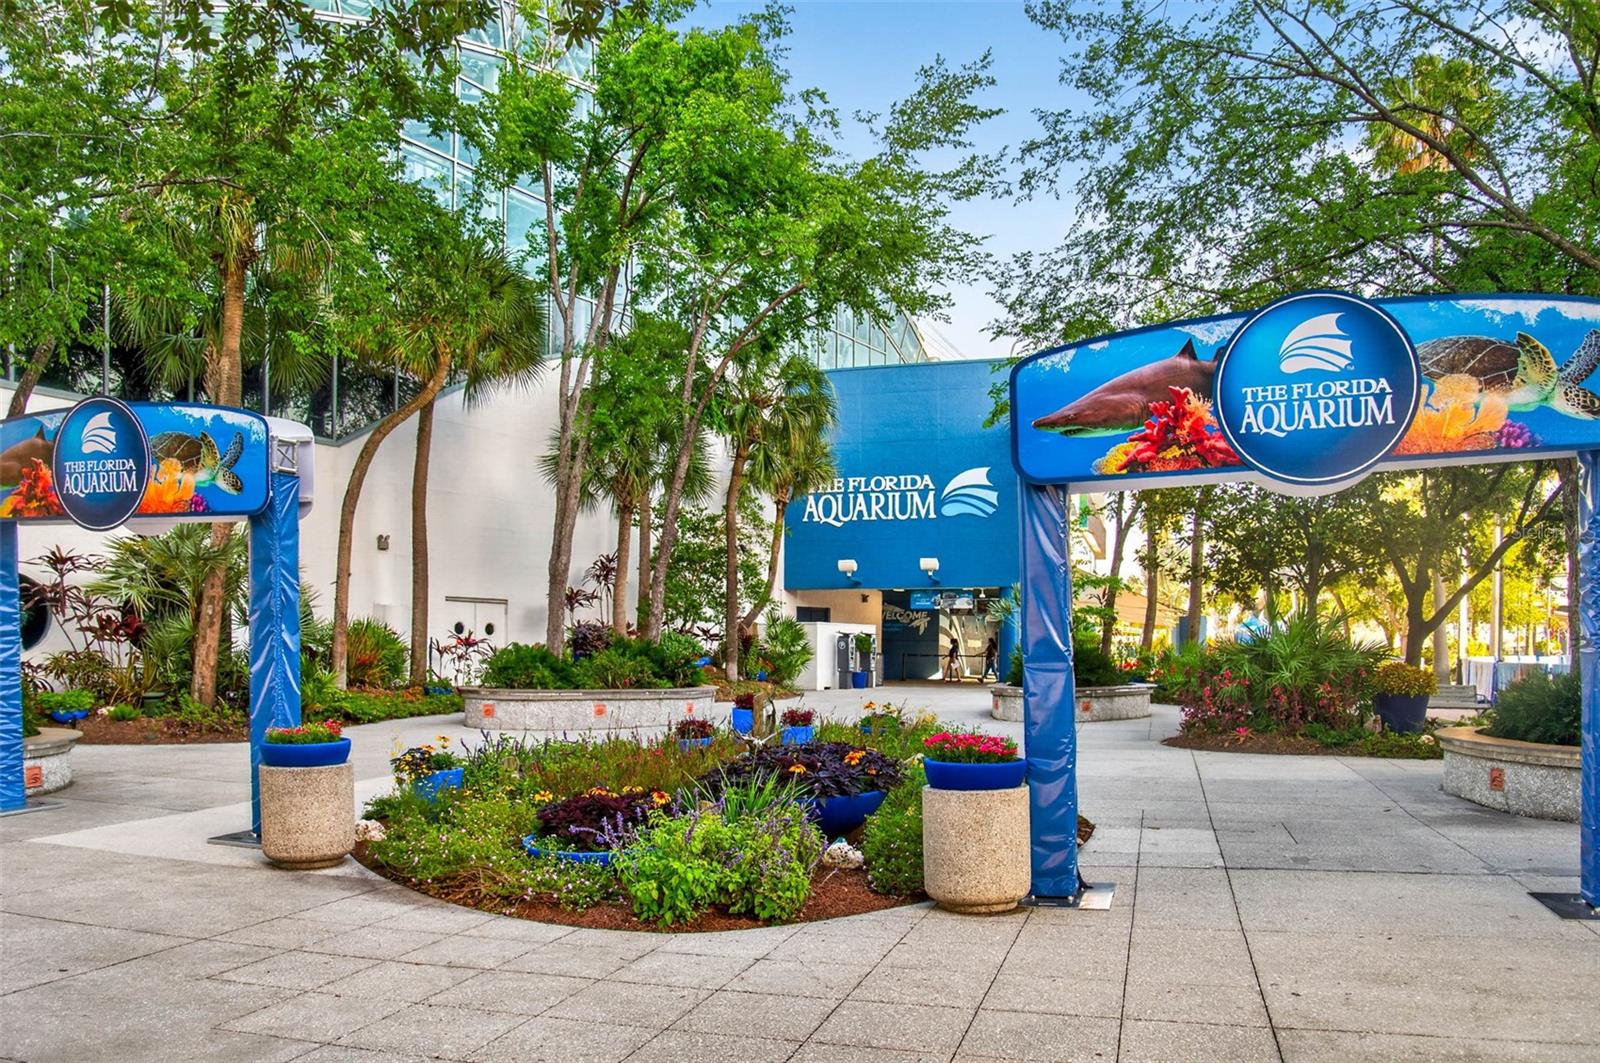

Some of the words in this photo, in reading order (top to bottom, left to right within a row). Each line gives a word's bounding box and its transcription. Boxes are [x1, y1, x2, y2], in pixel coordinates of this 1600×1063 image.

[1242, 387, 1287, 403] THE
[1291, 378, 1392, 400] FLORIDA
[1239, 394, 1395, 438] AQUARIUM
[64, 461, 85, 473] THE
[87, 459, 136, 472] FLORIDA
[63, 471, 138, 497] AQUARIUM
[808, 478, 844, 493] HE
[848, 475, 935, 492] FLORIDA
[802, 491, 936, 527] AQUARIUM
